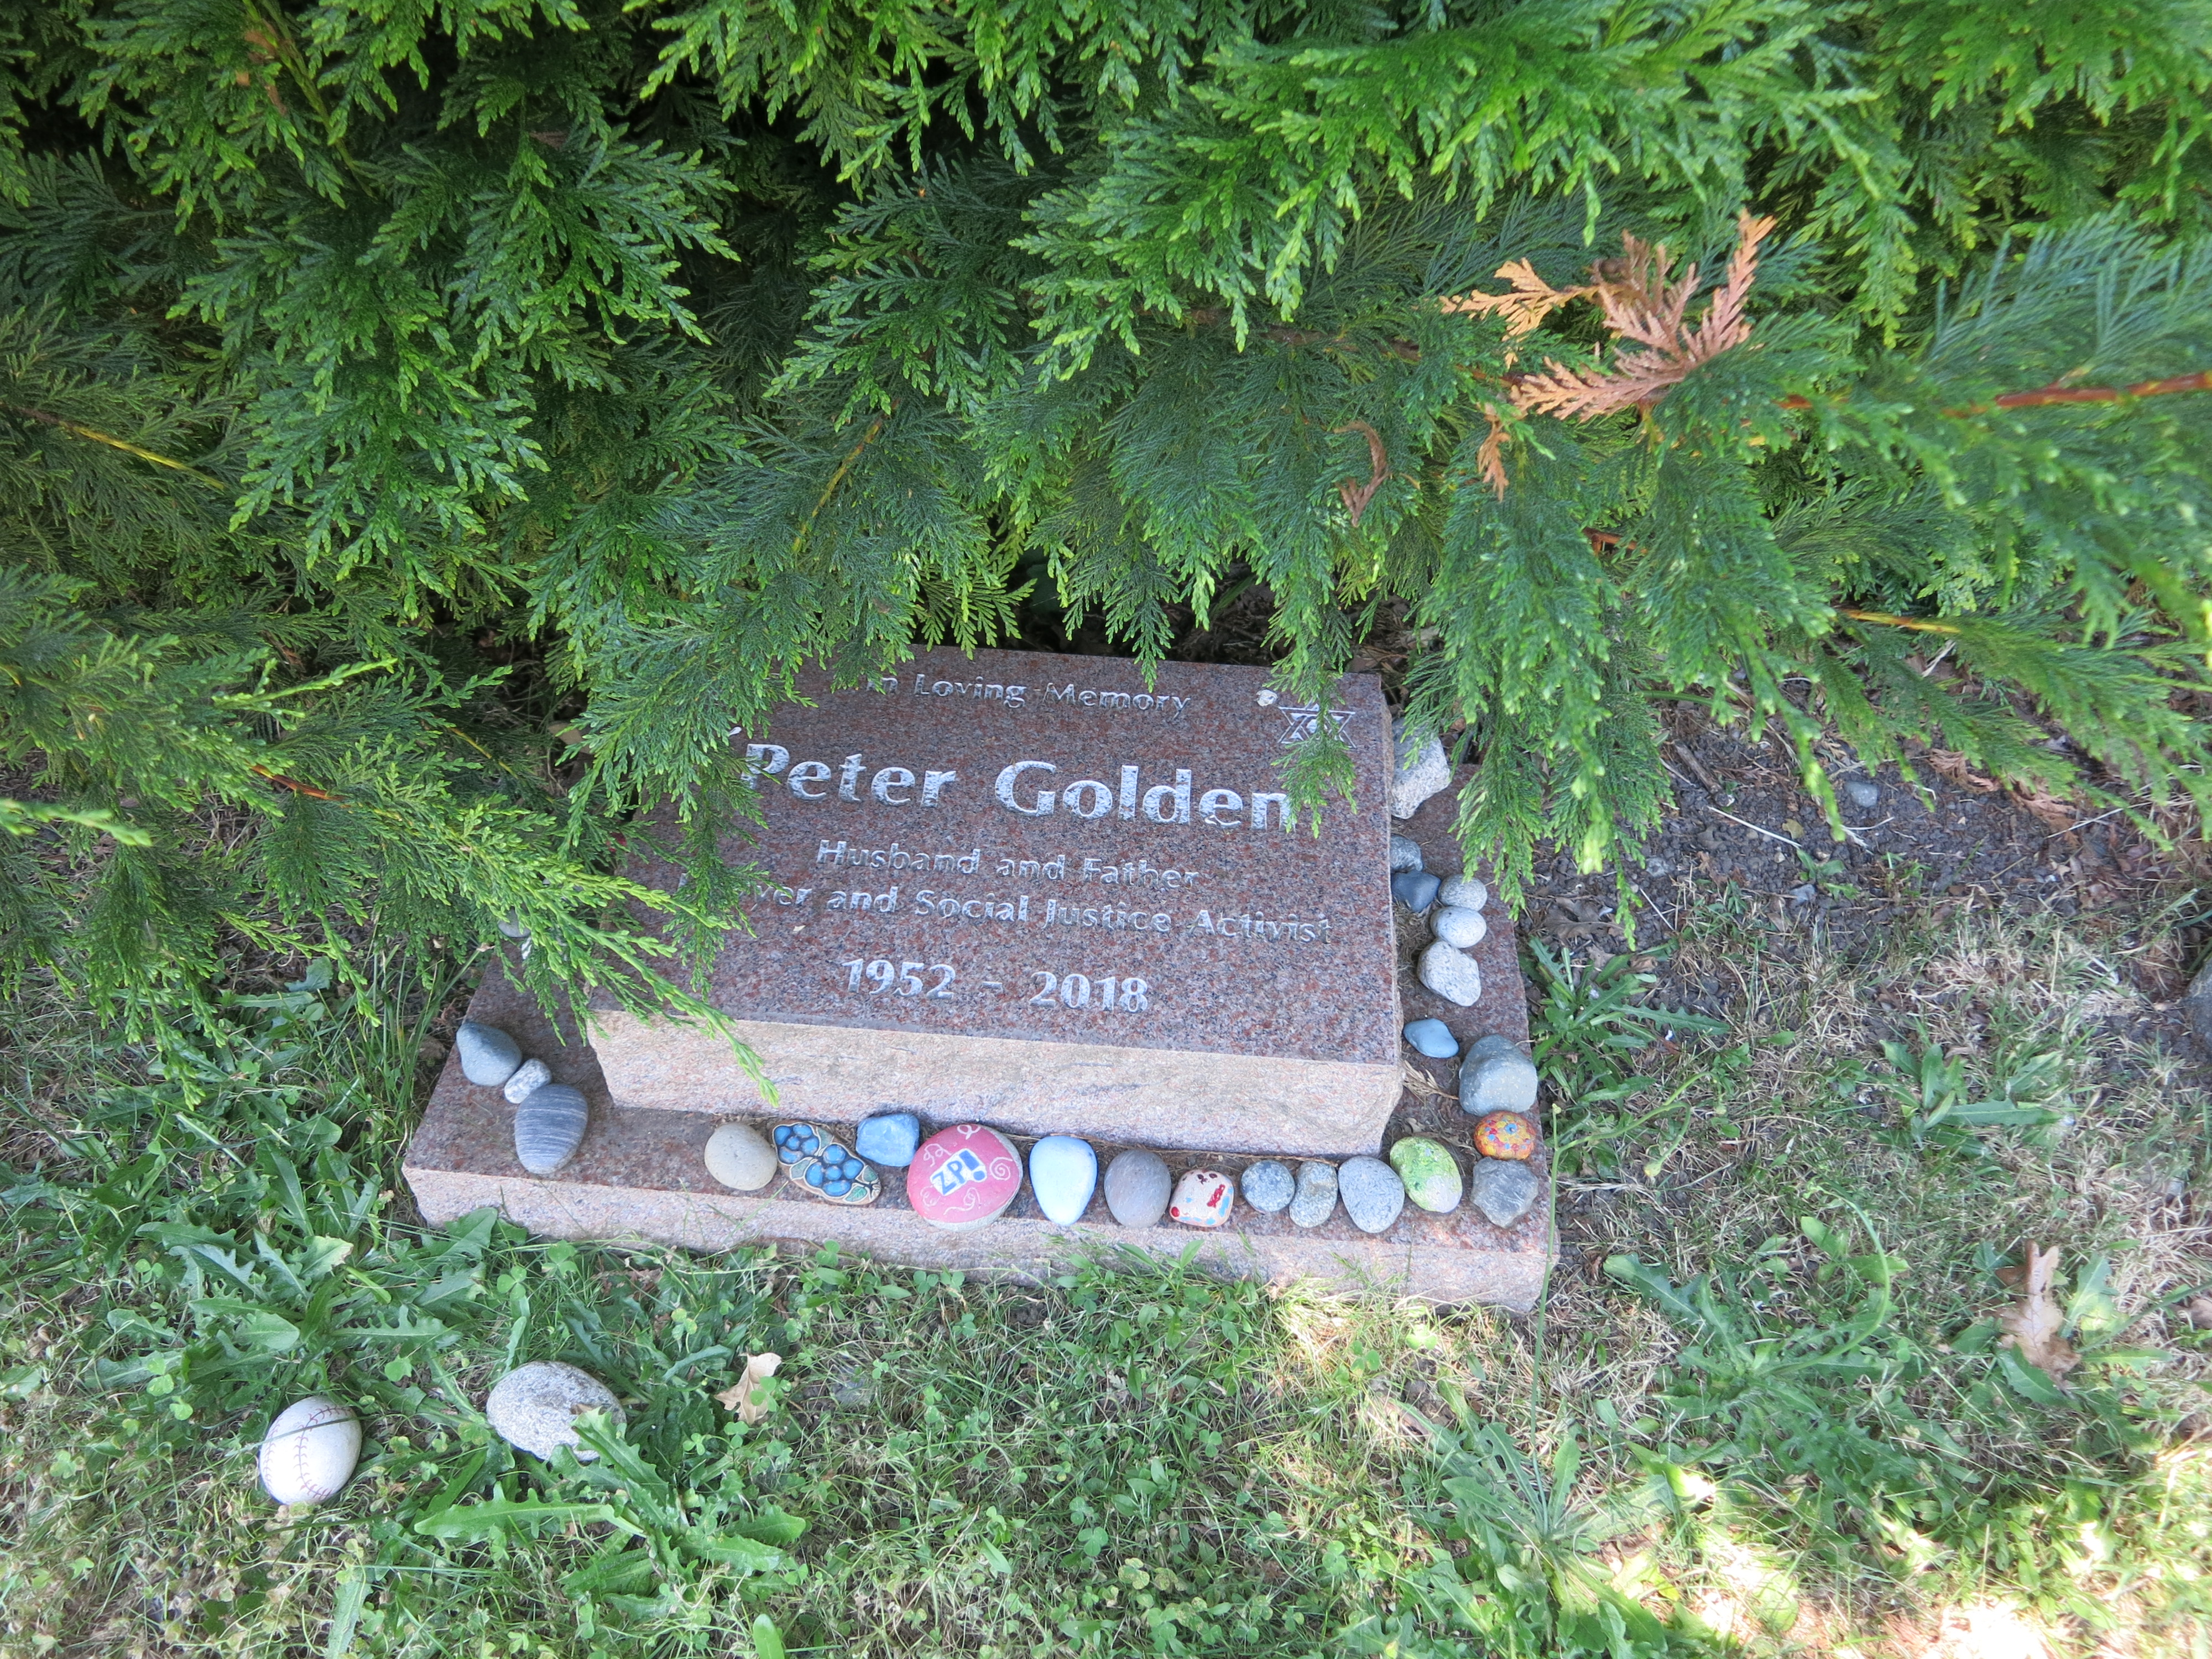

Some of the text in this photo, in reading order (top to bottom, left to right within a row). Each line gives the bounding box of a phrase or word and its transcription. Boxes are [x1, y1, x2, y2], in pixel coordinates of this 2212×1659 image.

[914, 673, 1027, 708] Loving
[1042, 682, 1191, 719] Memory
[740, 743, 1296, 830] Peter Golden
[816, 839, 1199, 888] Husband and Father
[827, 886, 898, 913] and
[915, 889, 1028, 922] Social
[1042, 899, 1171, 933] Justice
[1188, 910, 1331, 944] Activist
[842, 958, 956, 999] 1952
[1030, 971, 1149, 1014] 2018
[931, 1149, 986, 1196] ZP!
